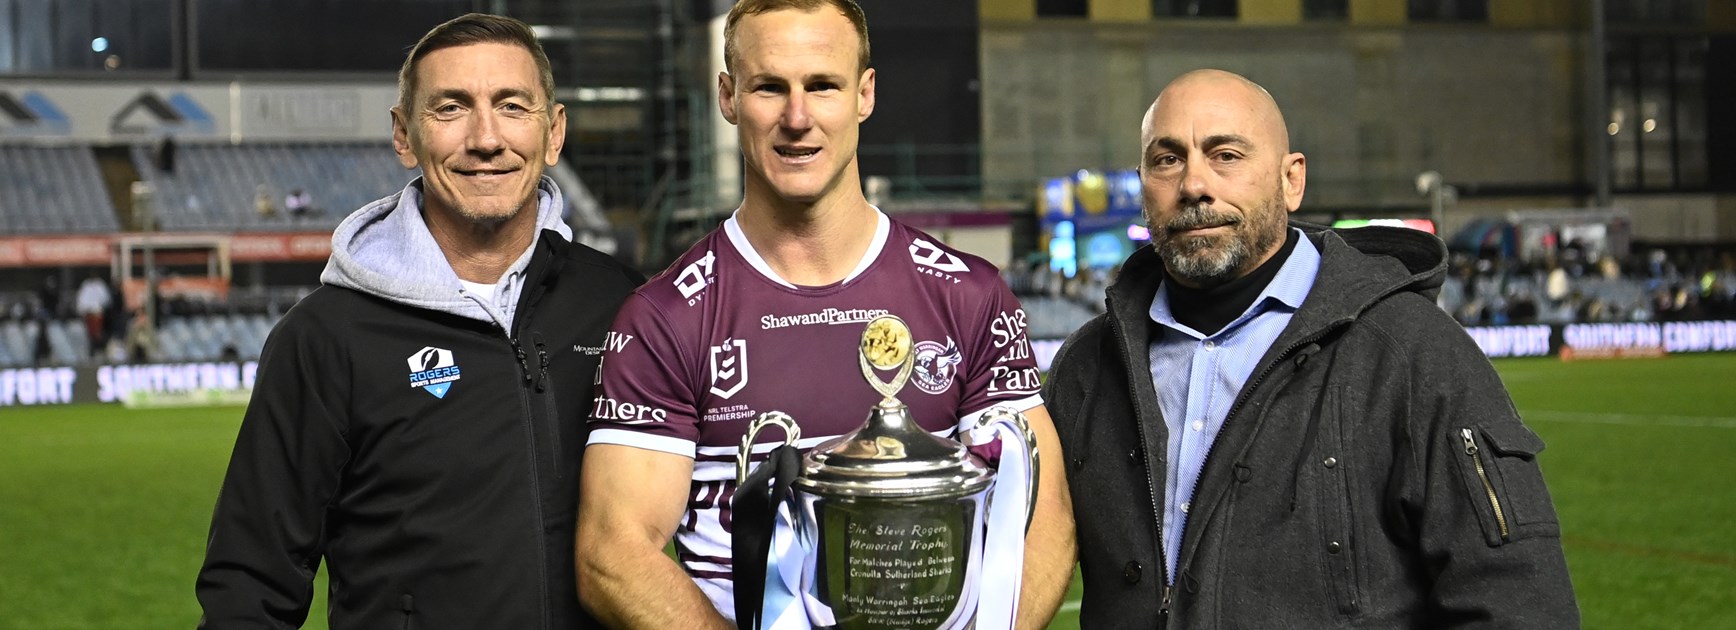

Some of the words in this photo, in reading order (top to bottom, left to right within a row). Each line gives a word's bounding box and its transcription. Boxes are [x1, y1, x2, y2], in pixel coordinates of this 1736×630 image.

[916, 266, 961, 285] NASTY
[409, 366, 460, 382] ROGERS
[720, 404, 749, 413] TELSTRA
[703, 410, 756, 422] PREMIERSHIP
[875, 524, 905, 536] Steve
[911, 524, 947, 537] Rogers
[849, 539, 904, 551] Memorial
[862, 557, 892, 567] Matches
[895, 558, 923, 569] Played
[850, 567, 881, 579] Cronulla
[885, 569, 927, 579] Sutherland
[842, 593, 864, 606] Manly
[865, 595, 908, 607] Warringah
